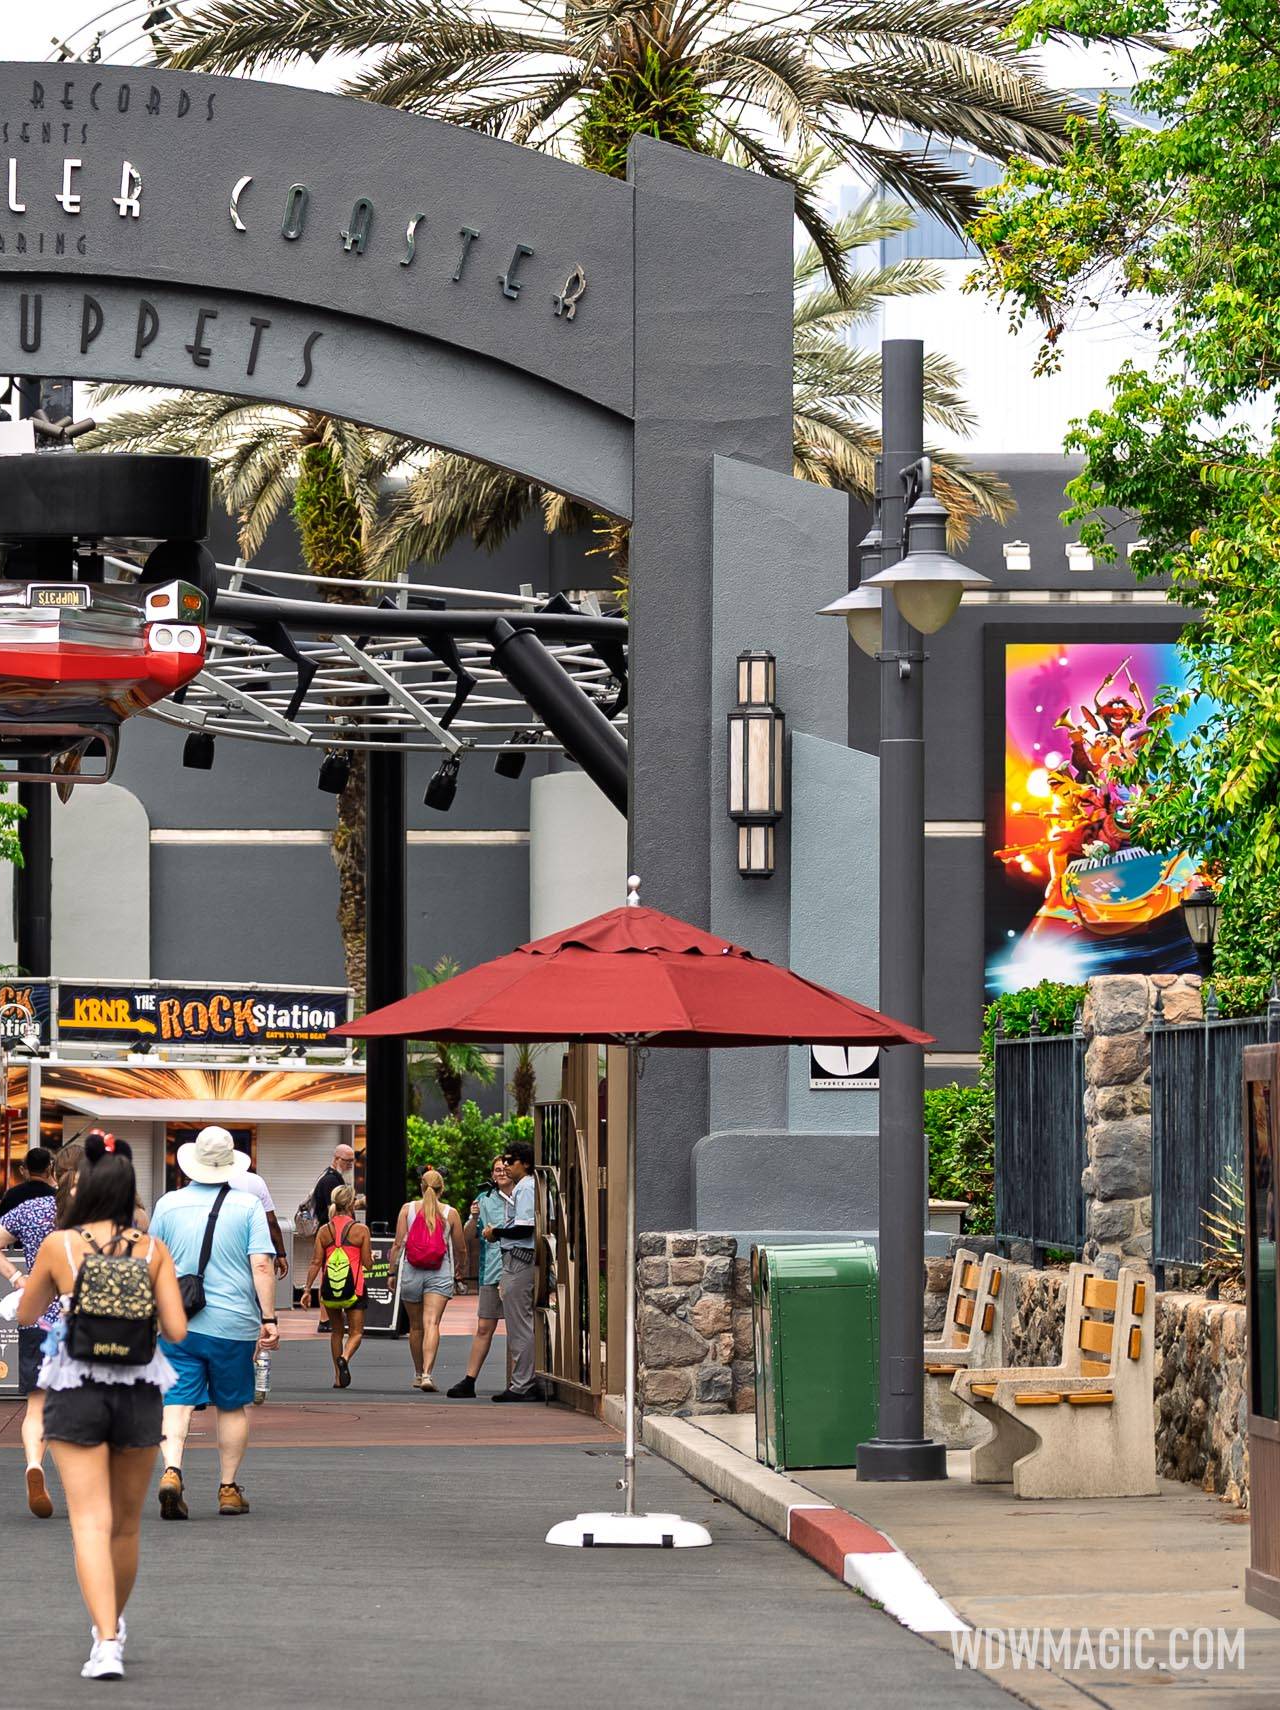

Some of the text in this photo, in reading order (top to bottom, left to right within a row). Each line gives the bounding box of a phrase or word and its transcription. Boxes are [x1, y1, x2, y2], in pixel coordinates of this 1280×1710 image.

[30, 80, 217, 121] RECORDS
[229, 175, 587, 321] COASTER
[74, 995, 336, 1040] KRNR THE ROCK Station
